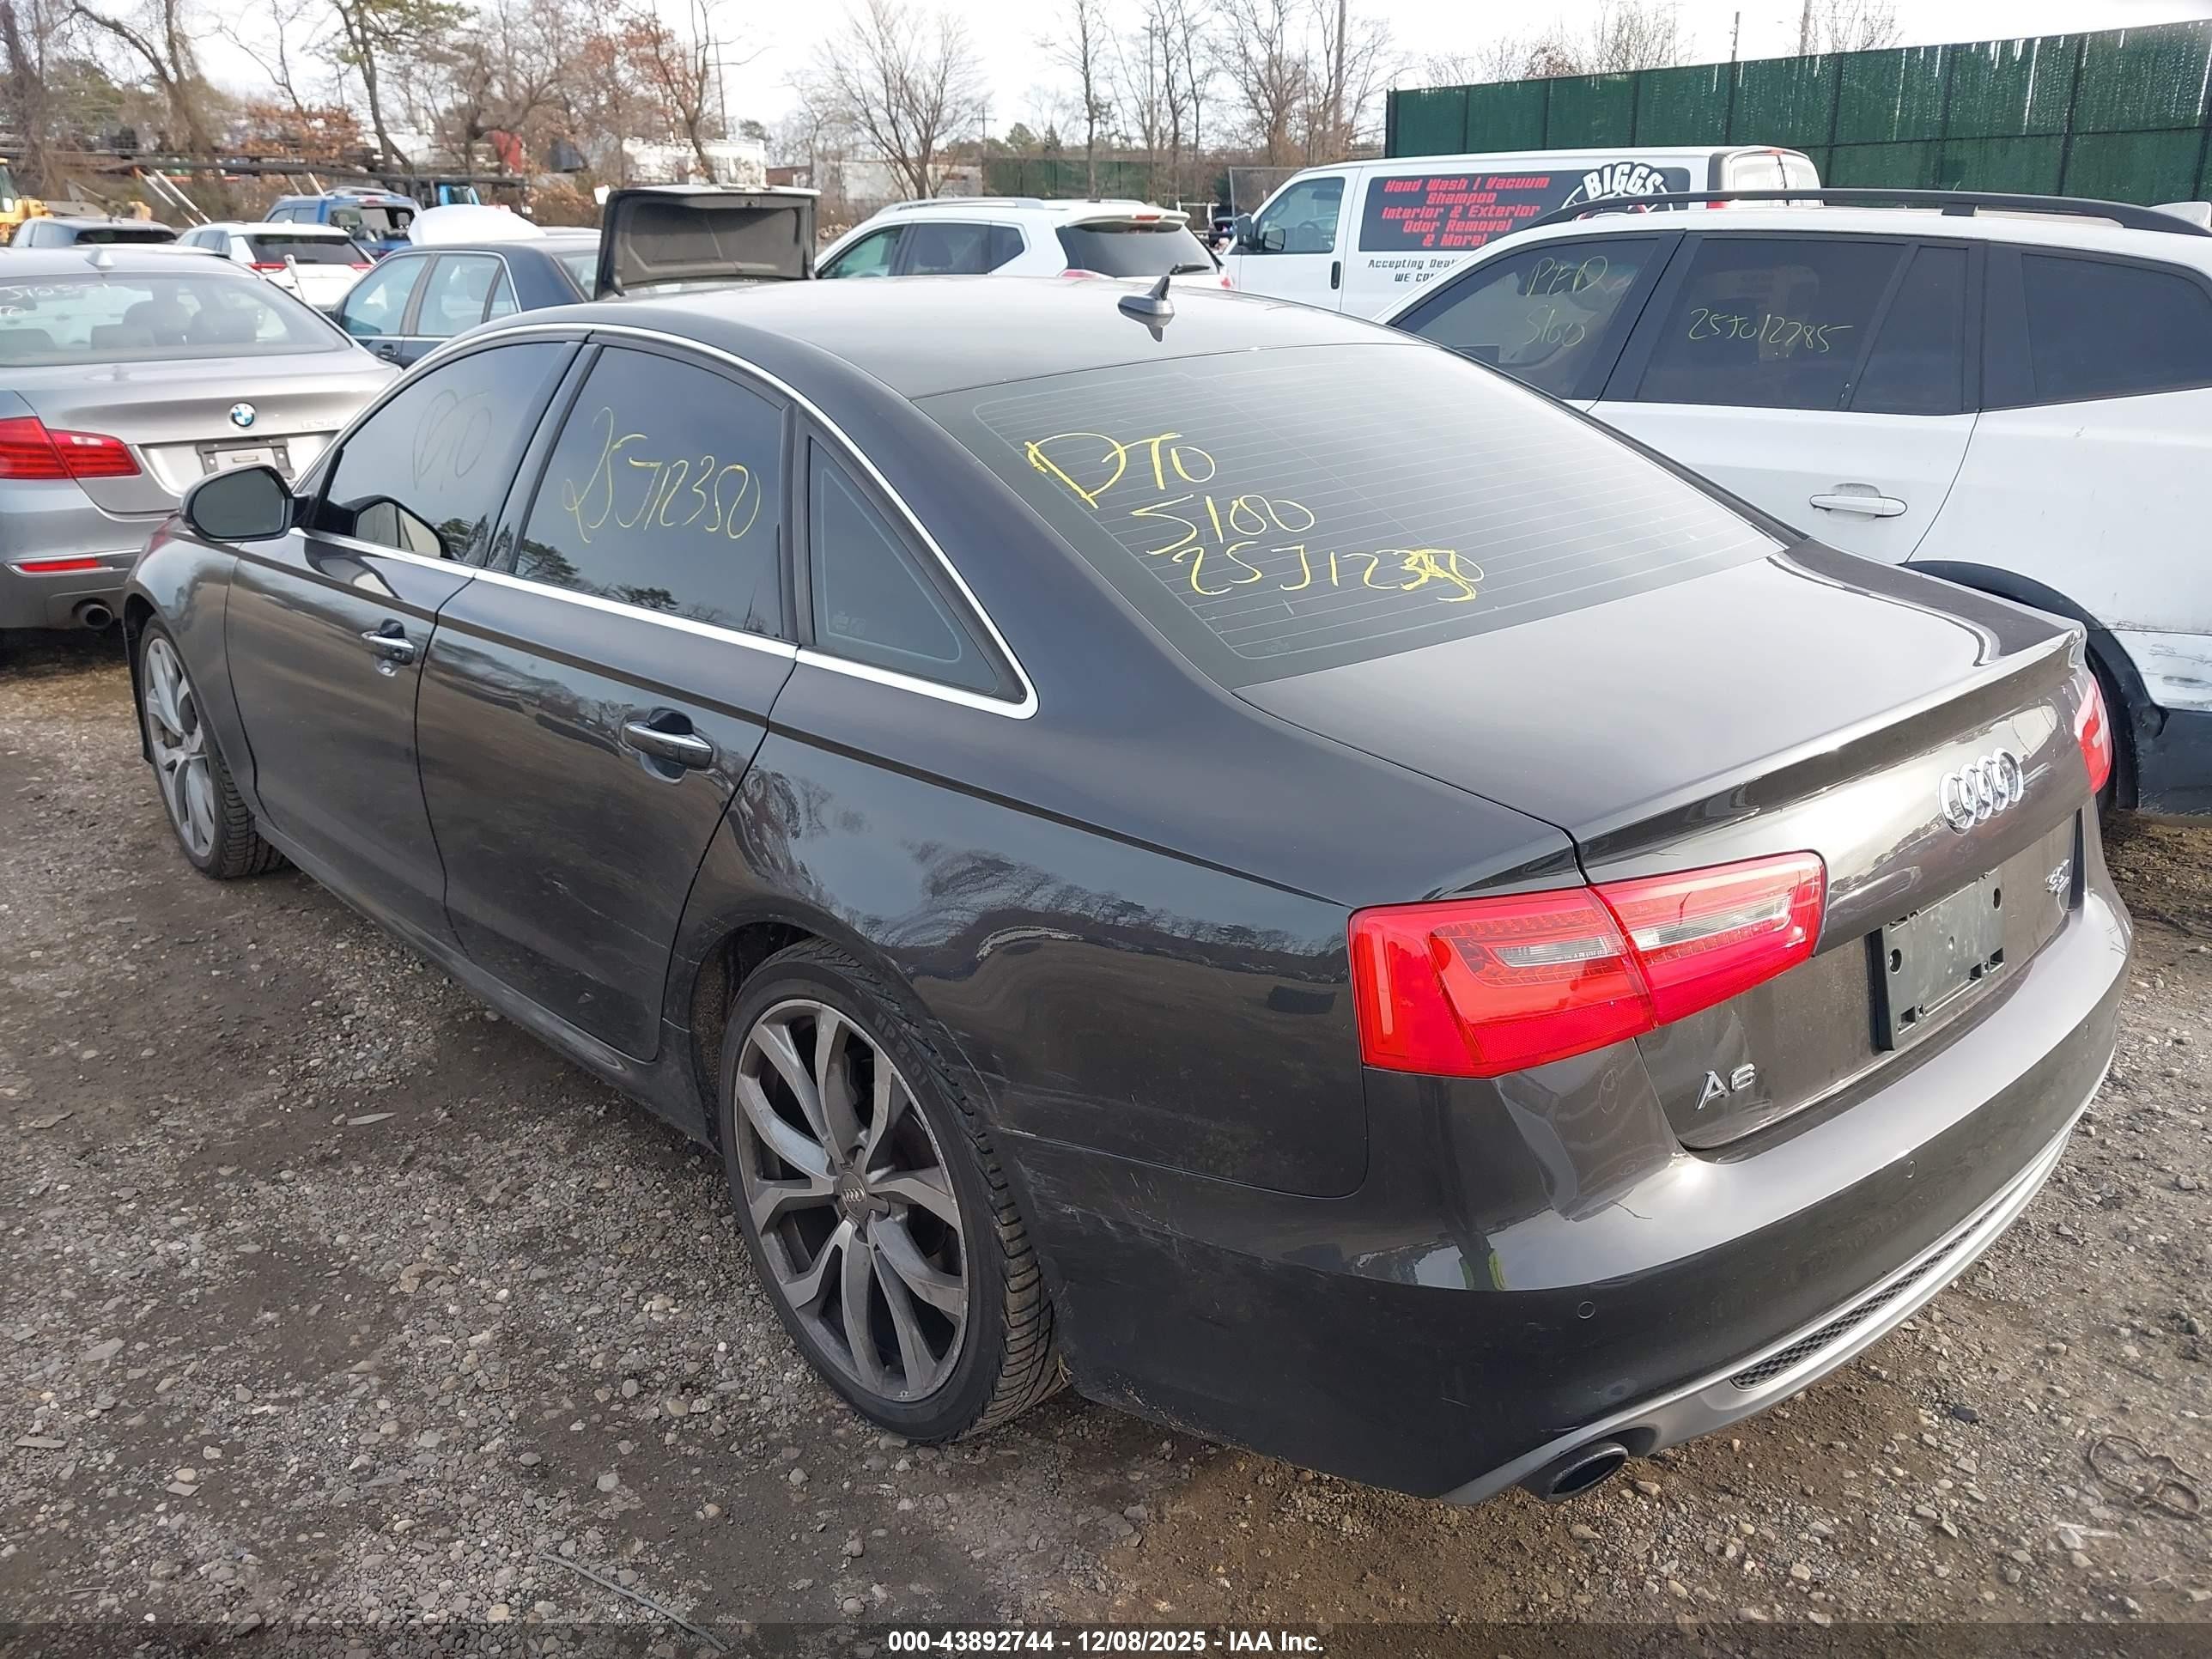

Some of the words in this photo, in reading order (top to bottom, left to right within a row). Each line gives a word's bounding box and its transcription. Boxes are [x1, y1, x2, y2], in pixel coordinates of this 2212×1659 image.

[1383, 179, 1423, 193] Hand
[1426, 178, 1468, 191] Wash
[1485, 177, 1550, 190] Vacuum
[1582, 162, 1665, 201] BIGGS
[1426, 191, 1497, 206] Shampoo
[1382, 206, 1443, 220] Interior
[1468, 204, 1540, 217] Exterior
[1402, 220, 1440, 233] Odor
[1445, 218, 1513, 233] Removal
[1440, 233, 1488, 246] More!
[1367, 258, 1425, 270] Accepting
[1394, 272, 1411, 283] WE
[1024, 432, 1216, 509] DTO
[1696, 1063, 1756, 1110] A6
